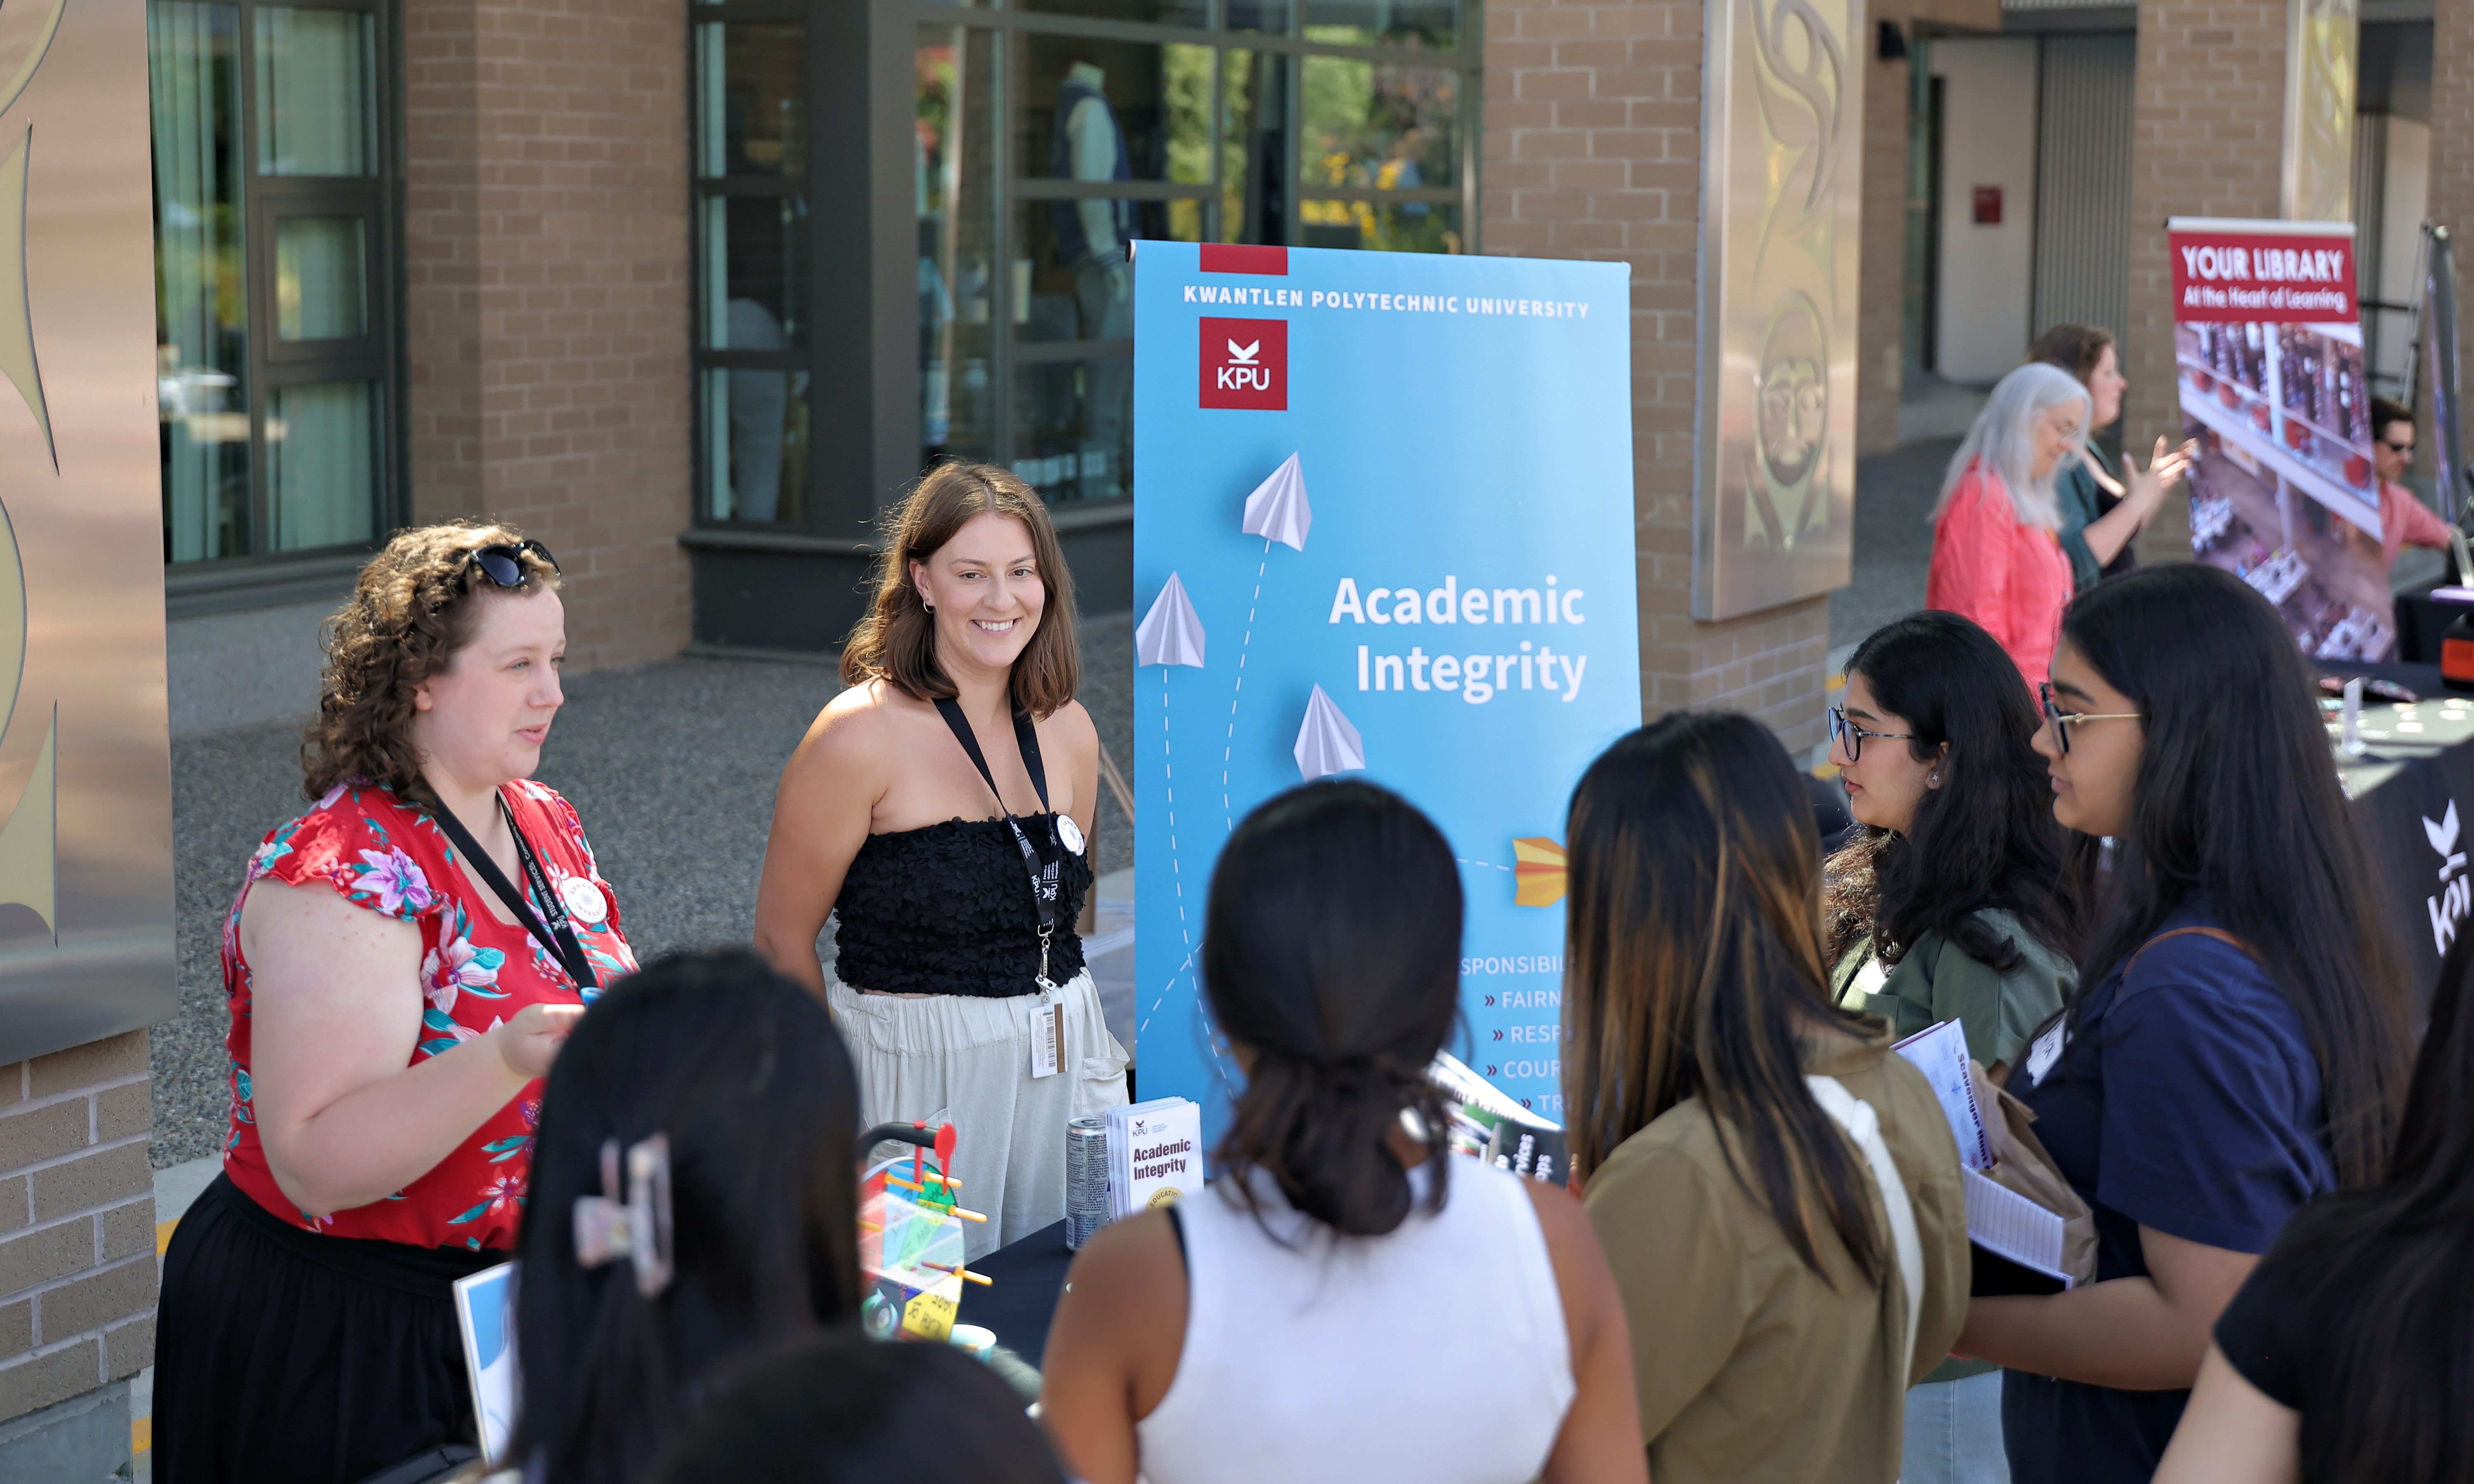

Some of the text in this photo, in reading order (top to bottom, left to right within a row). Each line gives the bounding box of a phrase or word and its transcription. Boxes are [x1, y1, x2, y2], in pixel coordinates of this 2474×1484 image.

[2181, 246, 2344, 282] YOUR LIBRARY
[1183, 285, 1590, 319] KWANTLEN POLYTECHNIC UNIVERSITY
[2183, 285, 2348, 314] At the Heart of Learning
[1217, 366, 1270, 391] KPU
[1329, 575, 1585, 624] Academic
[1357, 640, 1587, 704] Integrity
[1032, 874, 1040, 893] KPU
[1049, 883, 1058, 901] KPU
[541, 890, 558, 916] STUDENT
[1133, 1127, 1148, 1137] KPU
[1134, 1138, 1191, 1162] Academic
[1134, 1158, 1187, 1181] Integrity
[1150, 1190, 1180, 1207] EDUCATIO
